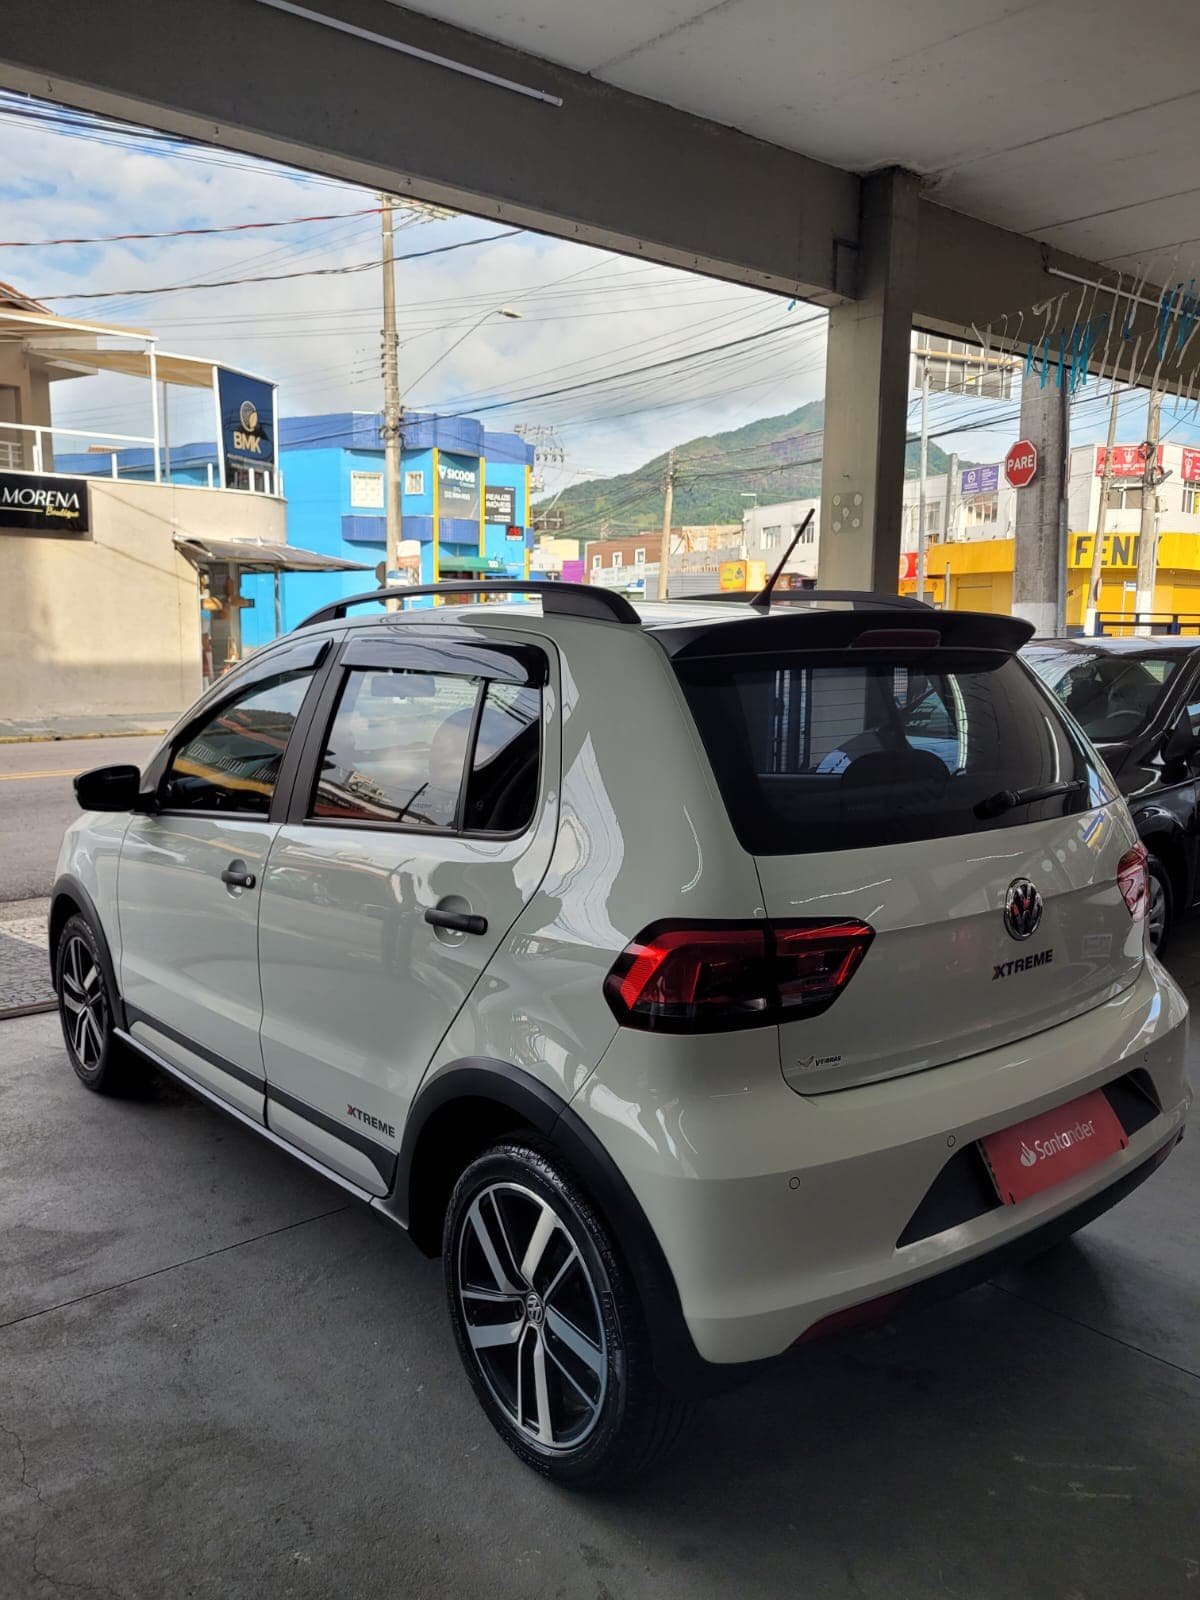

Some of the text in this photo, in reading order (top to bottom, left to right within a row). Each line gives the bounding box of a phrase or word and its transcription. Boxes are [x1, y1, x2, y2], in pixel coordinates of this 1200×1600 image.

[233, 431, 262, 454] BMK
[1007, 454, 1035, 472] PARE
[2, 486, 80, 509] MORENA
[992, 949, 1053, 981] XTREME
[346, 1103, 396, 1138] XTREME
[1034, 1120, 1096, 1160] Santander
